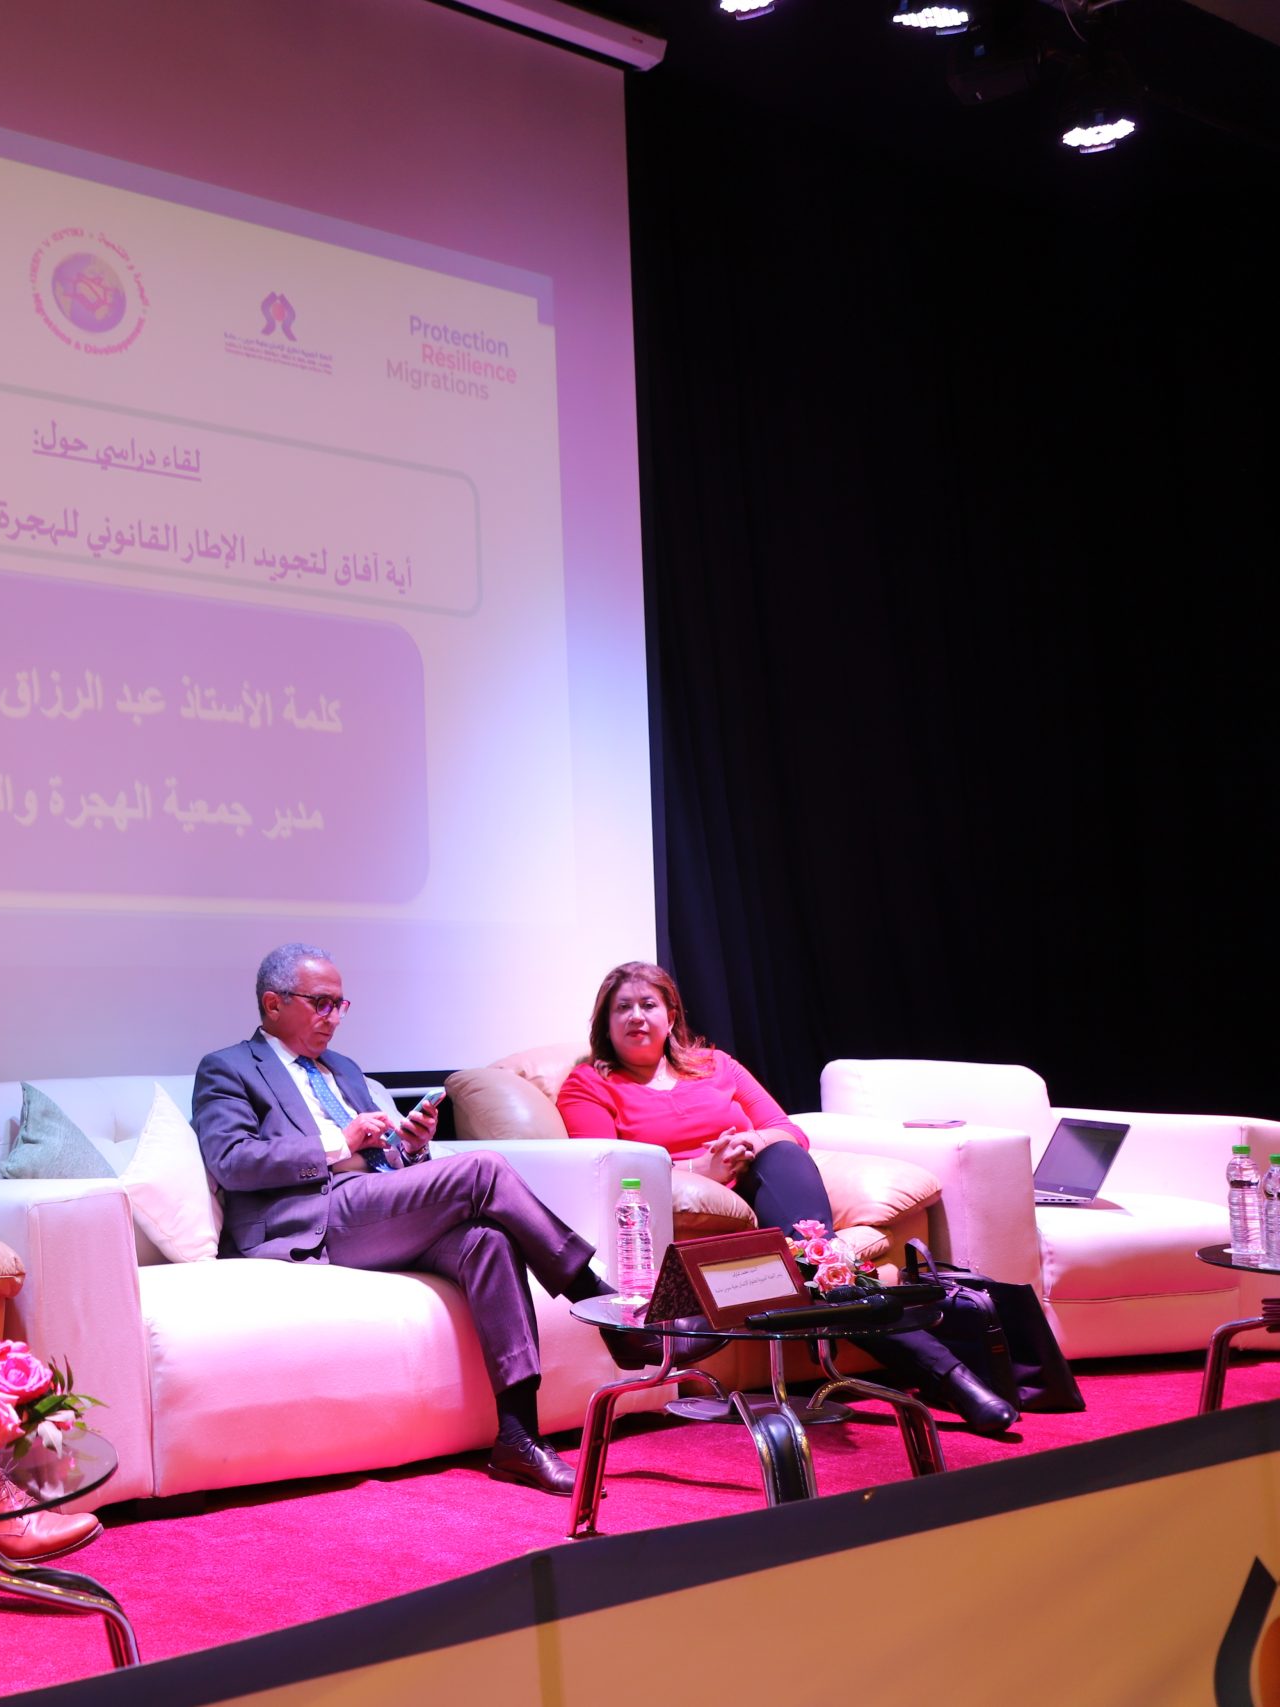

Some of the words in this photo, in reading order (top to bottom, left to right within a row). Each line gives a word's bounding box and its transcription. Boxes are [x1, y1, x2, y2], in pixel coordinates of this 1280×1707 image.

[408, 313, 510, 359] Protection
[386, 358, 490, 401] Migrations
[421, 343, 518, 385] Résilience
[32, 419, 89, 456] حول:
[95, 437, 156, 471] دراسي
[162, 445, 201, 473] لقاء
[86, 517, 179, 558] القانوني
[180, 528, 247, 569] الإطار
[253, 546, 328, 583] لتجويد
[385, 556, 413, 595] أية
[115, 681, 167, 727] عبد
[179, 675, 274, 729] الأستاذ
[282, 685, 345, 734] كلمة
[48, 775, 154, 832] الهجرة
[162, 776, 254, 836] جمعية
[262, 800, 325, 840] مدير
